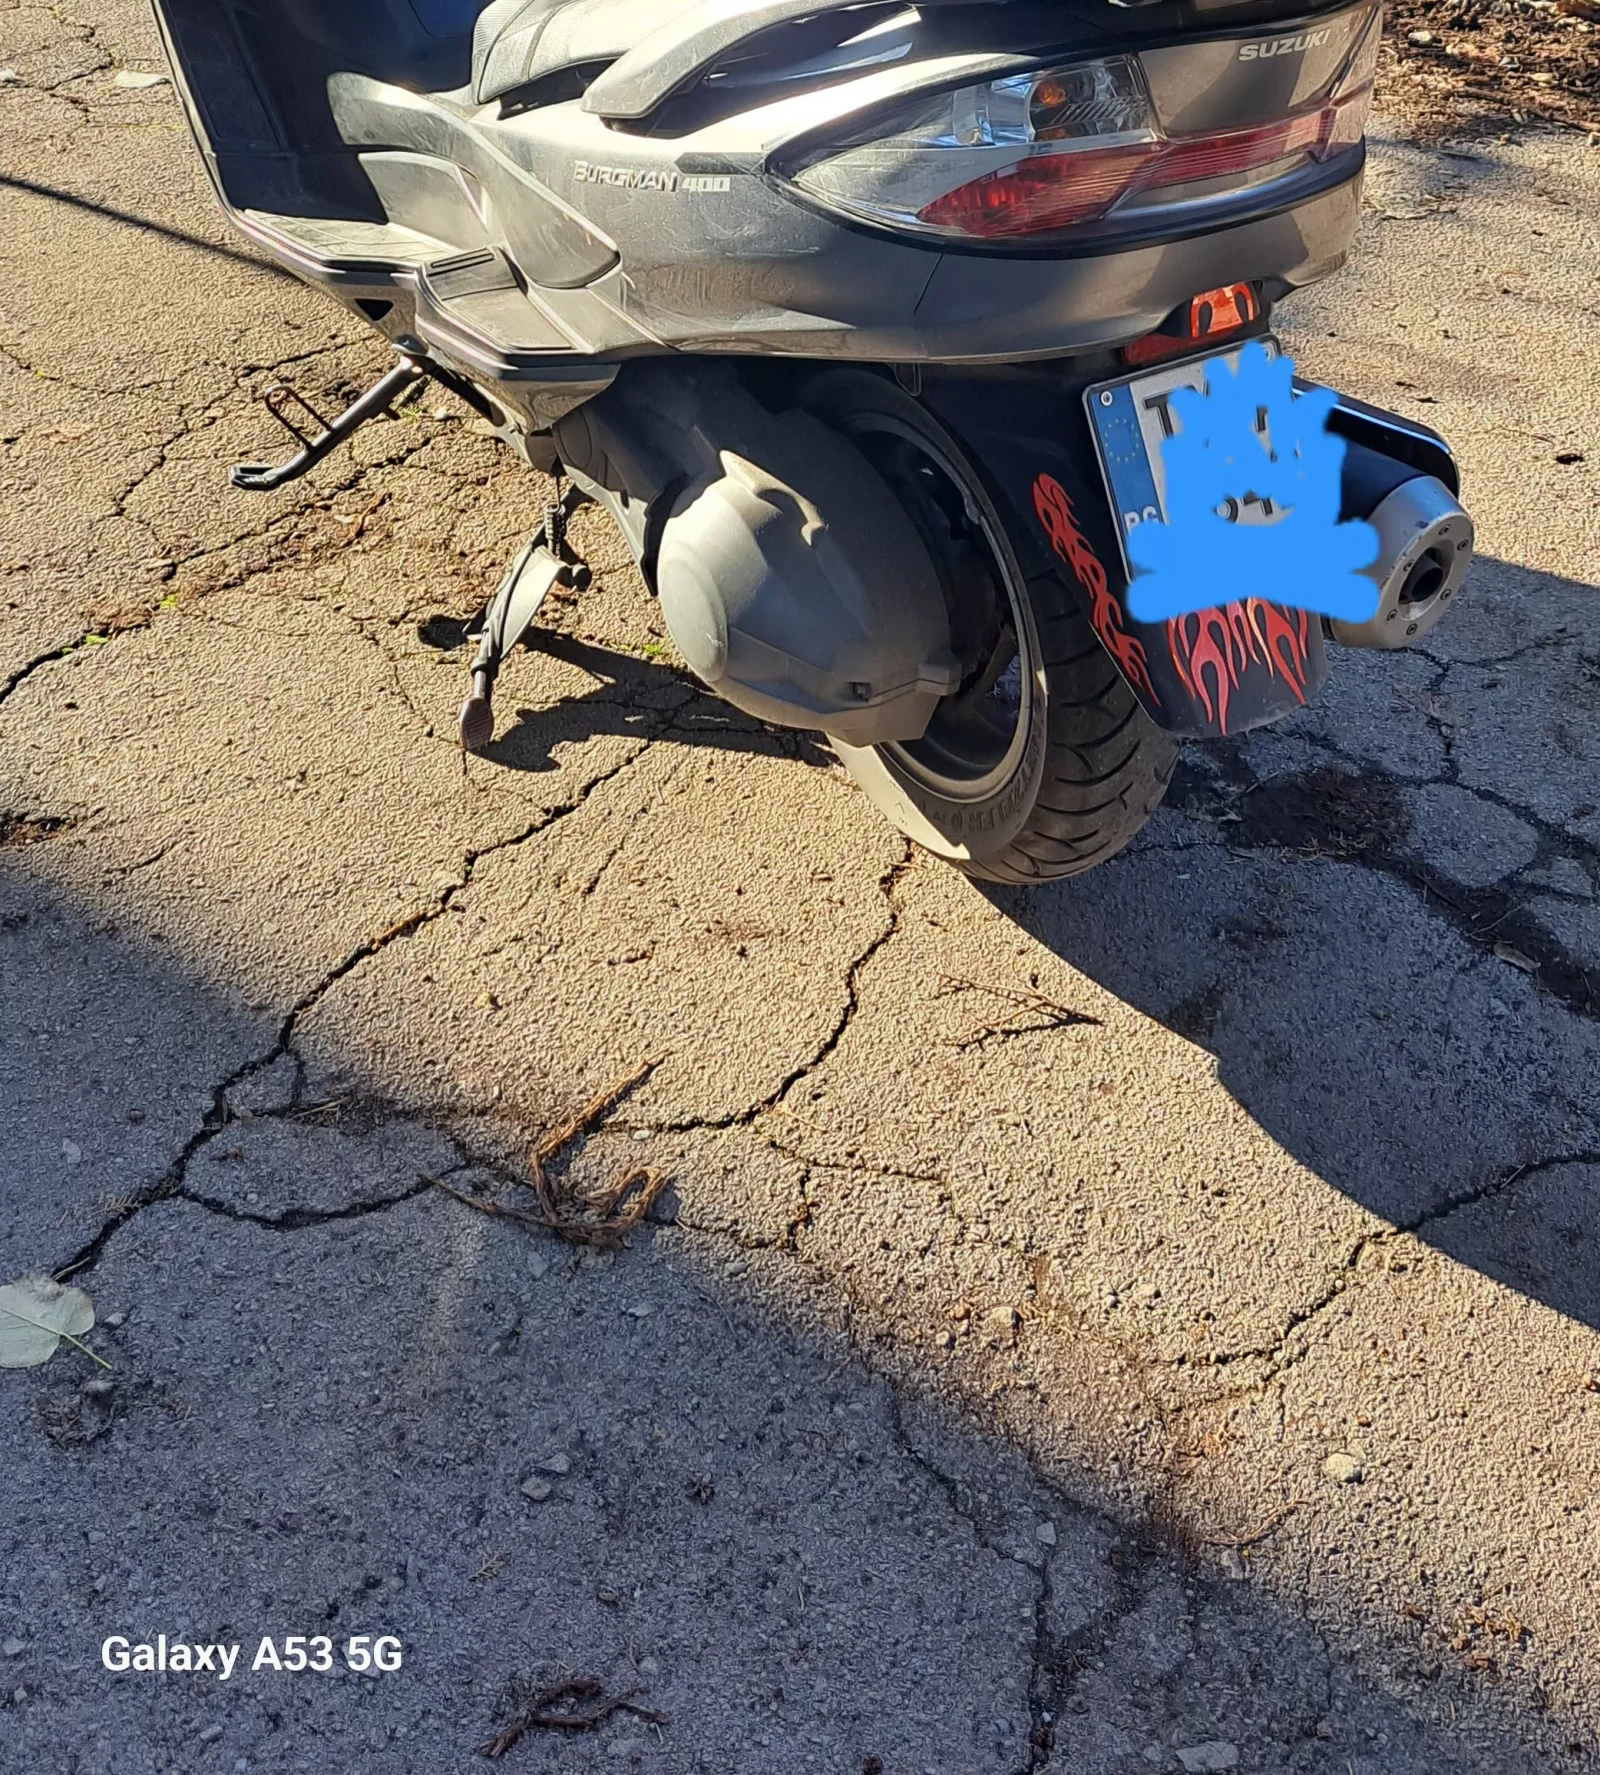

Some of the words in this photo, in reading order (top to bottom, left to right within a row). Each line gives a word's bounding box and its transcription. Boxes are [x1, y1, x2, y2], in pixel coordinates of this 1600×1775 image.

[1238, 28, 1332, 61] SUZUKI
[573, 159, 679, 193] BURGMAN
[681, 176, 731, 192] 400
